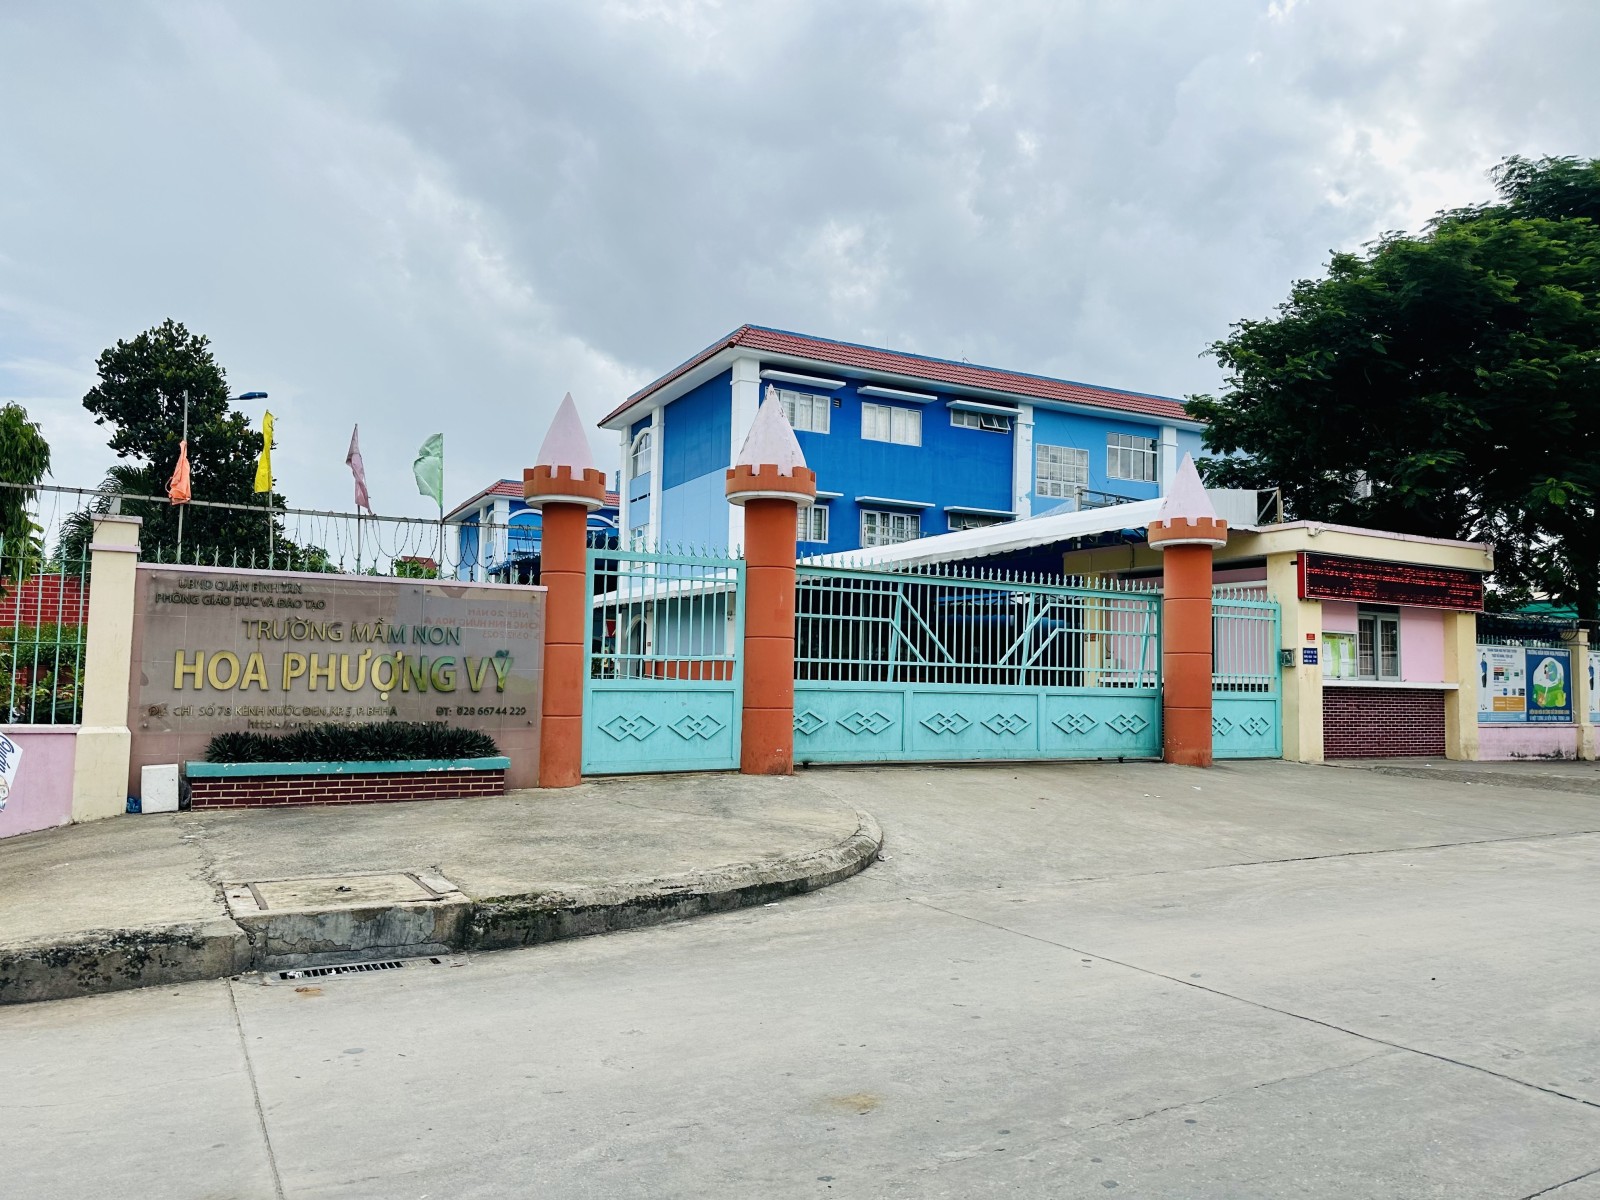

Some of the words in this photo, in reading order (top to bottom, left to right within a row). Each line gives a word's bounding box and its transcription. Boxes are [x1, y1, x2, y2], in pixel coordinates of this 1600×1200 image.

[179, 578, 213, 590] UBND
[154, 592, 199, 605] PHÒNG
[202, 594, 231, 606] GIÁO
[234, 595, 259, 609] DỤC
[261, 597, 274, 607] VÀ
[277, 598, 302, 609] ĐÀO
[304, 600, 326, 611] TẠO
[242, 615, 344, 643] TRƯỜNG
[350, 617, 407, 645] MẦM
[412, 625, 460, 646] NON
[173, 649, 269, 692] HOA
[282, 648, 456, 701] PHƯỢNG
[217, 705, 232, 717] 78
[477, 706, 507, 716] 66744
[509, 706, 527, 716] 229
